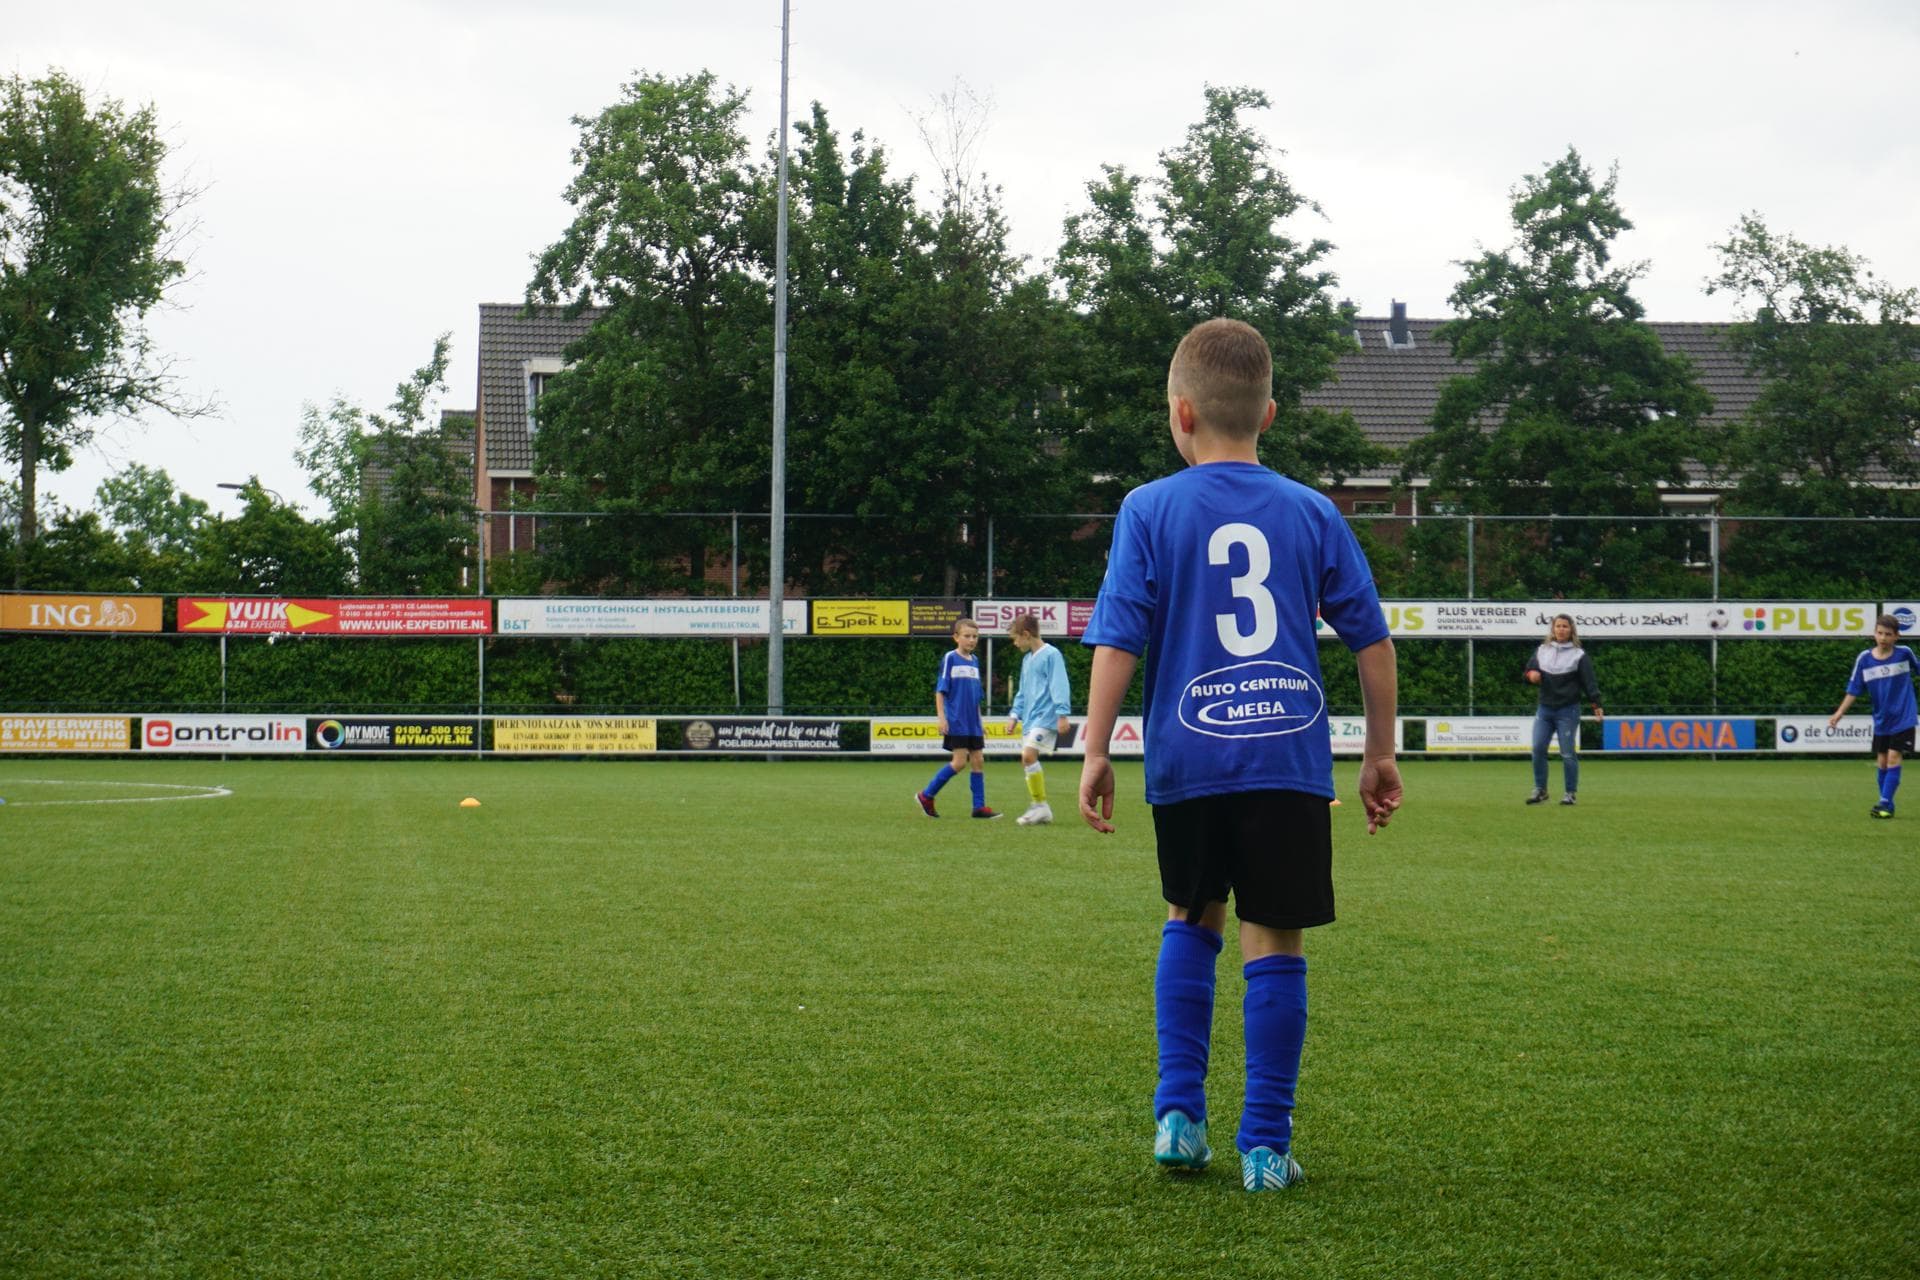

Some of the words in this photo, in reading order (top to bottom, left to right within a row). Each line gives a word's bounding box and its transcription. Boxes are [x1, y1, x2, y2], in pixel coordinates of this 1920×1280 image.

[1208, 522, 1278, 657] 3
[29, 603, 92, 627] ING
[229, 602, 289, 619] VUIK
[545, 605, 649, 614] ELECTROTECHNISCH
[654, 605, 760, 615] INSTALLATIEBEDRIJF
[1001, 605, 1057, 620] SPEK
[1437, 607, 1468, 616] PLUS
[1471, 607, 1527, 616] VERGEER
[250, 620, 287, 629] EXPEDITIE
[339, 619, 488, 631] WWW.VUIK-EXPEDITIE.NL
[503, 618, 530, 630] B&T
[1387, 607, 1425, 630] US
[1576, 610, 1629, 626] scoort
[1630, 616, 1638, 626] u
[1641, 611, 1689, 626] zeker!
[1772, 607, 1865, 631] PLUS
[1191, 683, 1236, 698] AUTO
[1239, 678, 1309, 693] CENTRUM
[1227, 700, 1286, 720] MEGA
[1, 719, 126, 729] GRAVEERWERK
[395, 725, 421, 735] 0180
[1342, 722, 1366, 736] Zn.
[1805, 724, 1822, 737] de
[1825, 724, 1873, 738] Onderl
[1, 730, 13, 739] &
[394, 734, 473, 745] MYMOVE.NL
[1619, 721, 1737, 749] MAGNA
[718, 739, 840, 748] POELIERJAAPWESTBROEK.NL
